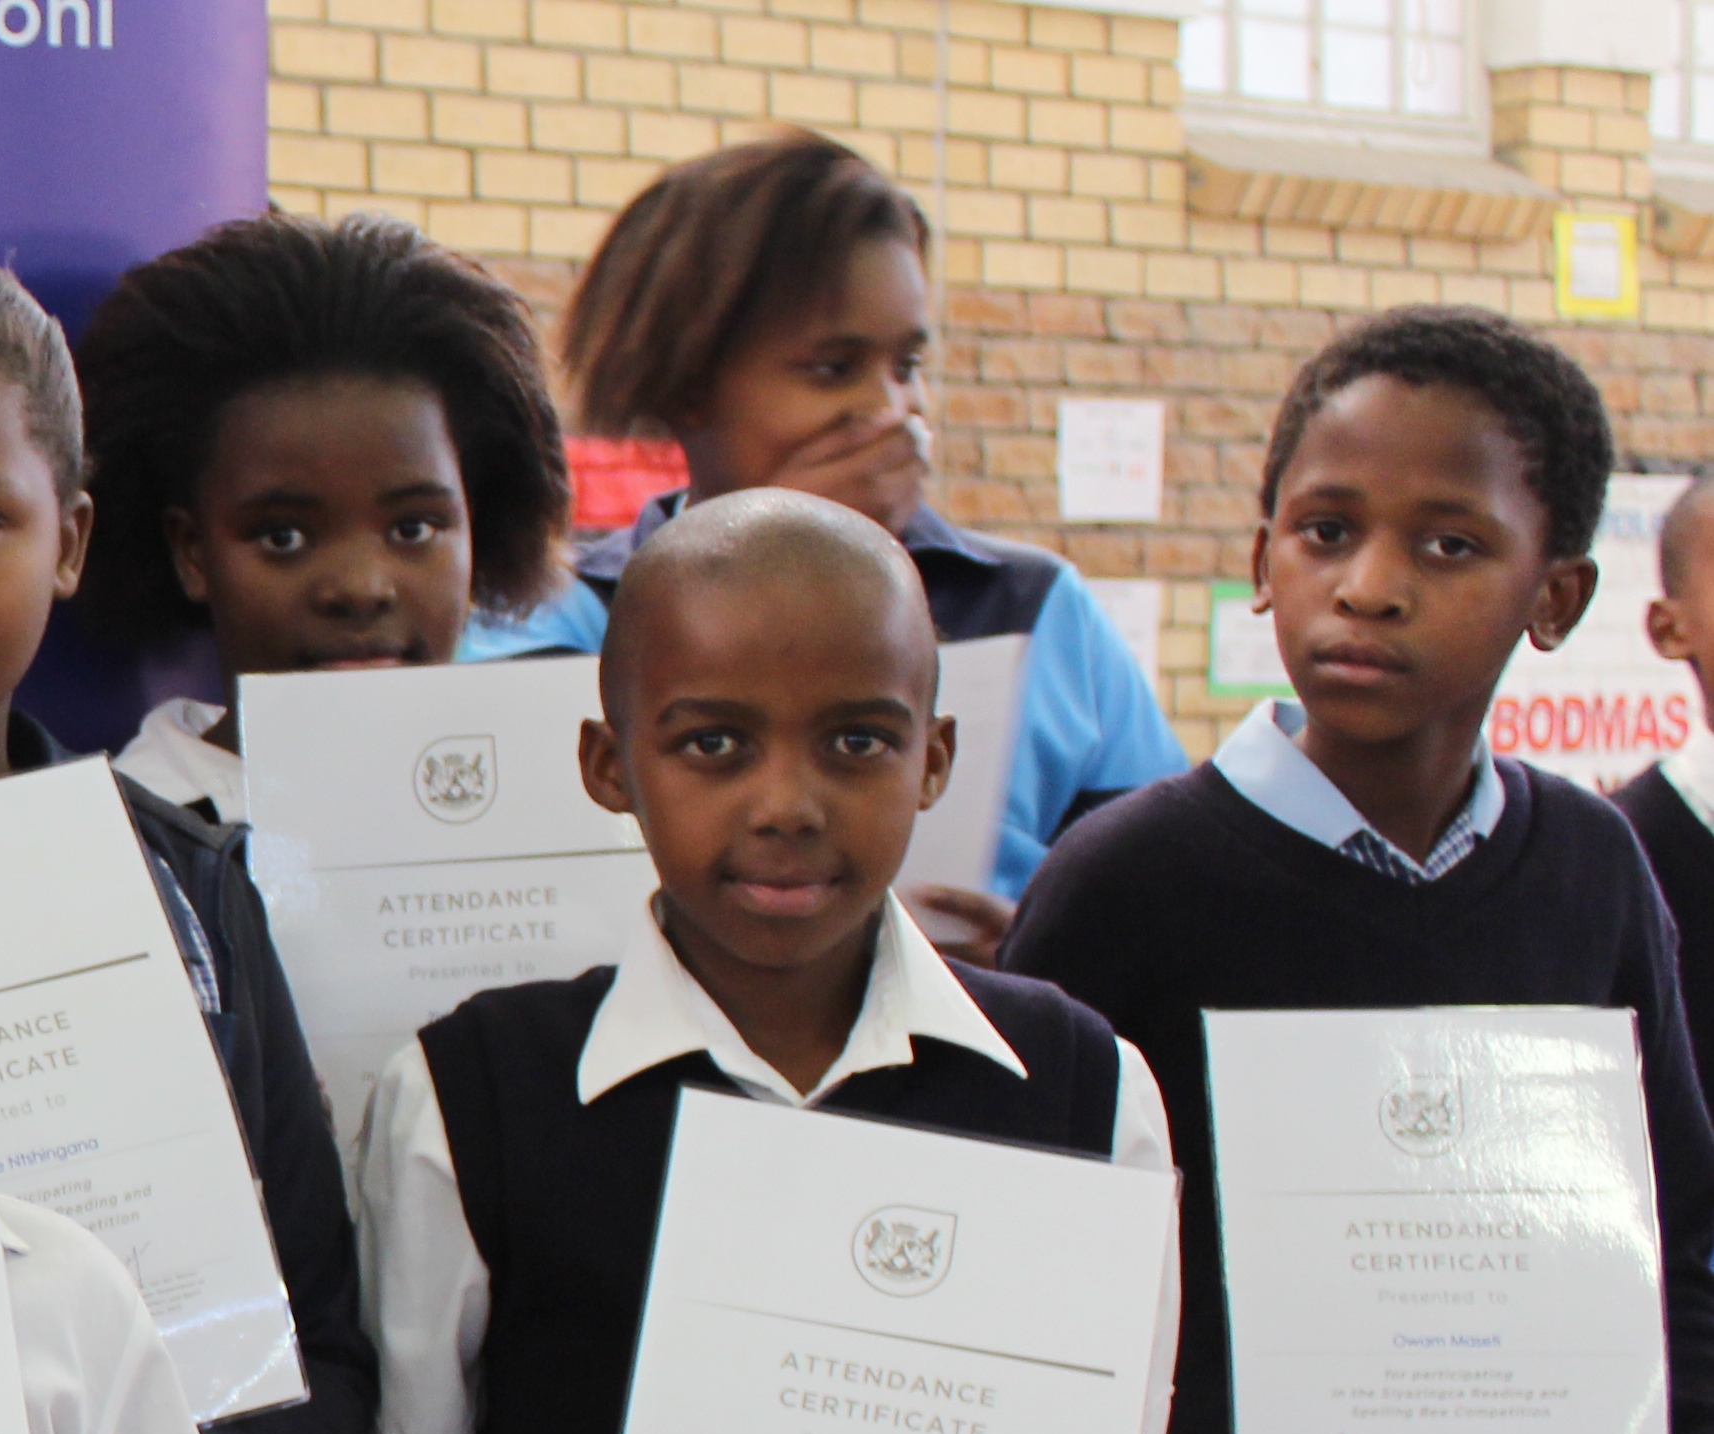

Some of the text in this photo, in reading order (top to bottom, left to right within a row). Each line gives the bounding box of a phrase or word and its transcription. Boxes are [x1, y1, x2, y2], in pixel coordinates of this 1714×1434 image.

[1492, 692, 1690, 755] BODMAS
[378, 886, 558, 915] ATTENDANCE
[382, 921, 557, 948] CERTIFICATE
[45, 1093, 68, 1110] to
[124, 1184, 153, 1202] and
[1345, 1221, 1532, 1240] ATTENDANCE
[1350, 1252, 1530, 1272] CERTIFICATE
[780, 1351, 997, 1409] ATTENDANCE
